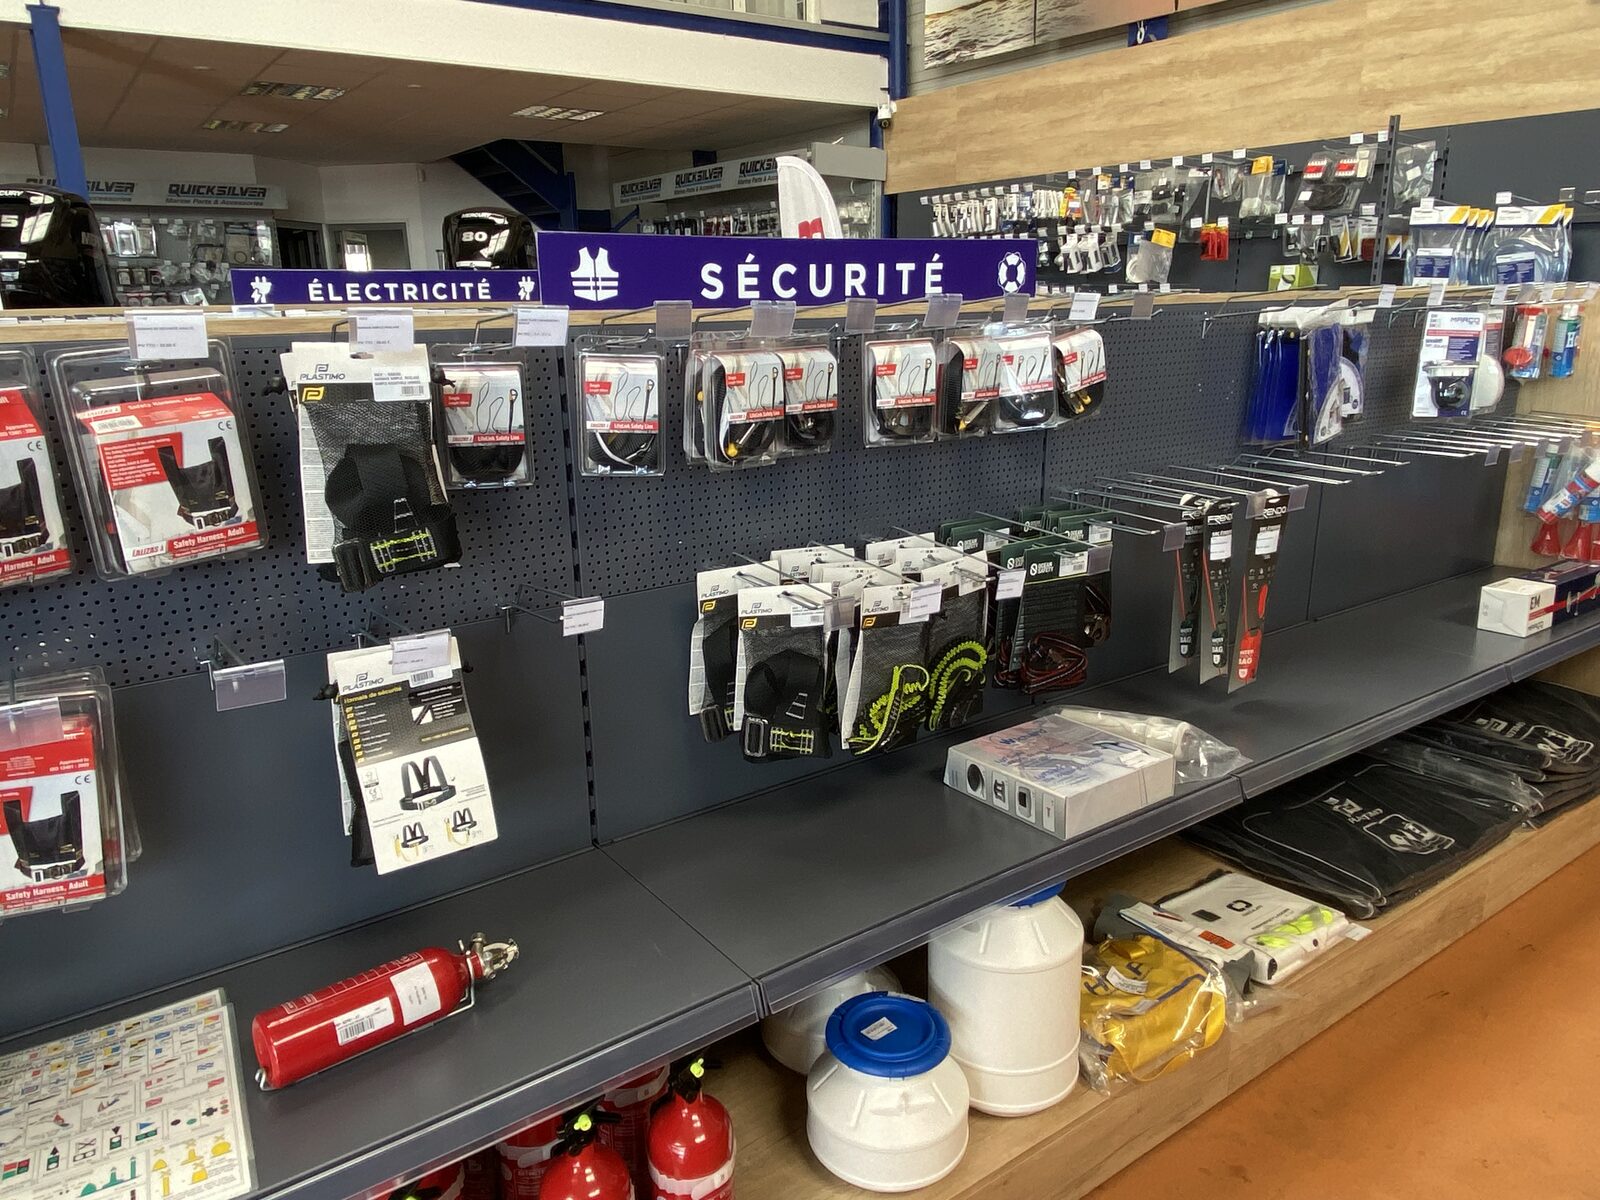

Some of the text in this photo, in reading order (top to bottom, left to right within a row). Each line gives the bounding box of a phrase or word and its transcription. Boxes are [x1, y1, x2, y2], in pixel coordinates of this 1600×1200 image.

[739, 158, 777, 177] QUICKSI
[675, 167, 723, 187] QUICKSILVER
[168, 184, 267, 197] QUICKSILVER
[620, 178, 661, 195] QUICKSILVER
[462, 231, 487, 242] 80
[700, 253, 943, 299] SÉCURITÉ
[308, 278, 491, 301] ÉLECTRICITÉ
[1207, 513, 1233, 525] FREND
[1263, 506, 1287, 519] RENDO
[173, 527, 245, 549] Safety Harness, Adult
[4, 554, 56, 572] Harness, Adult
[1037, 566, 1054, 574] SAFETY
[701, 589, 729, 598] PLASTIMO
[1530, 595, 1540, 610] EM
[342, 677, 384, 692] PLASTIMO
[344, 694, 368, 704] Harnais
[5, 880, 88, 901] Safety Harness, Adult
